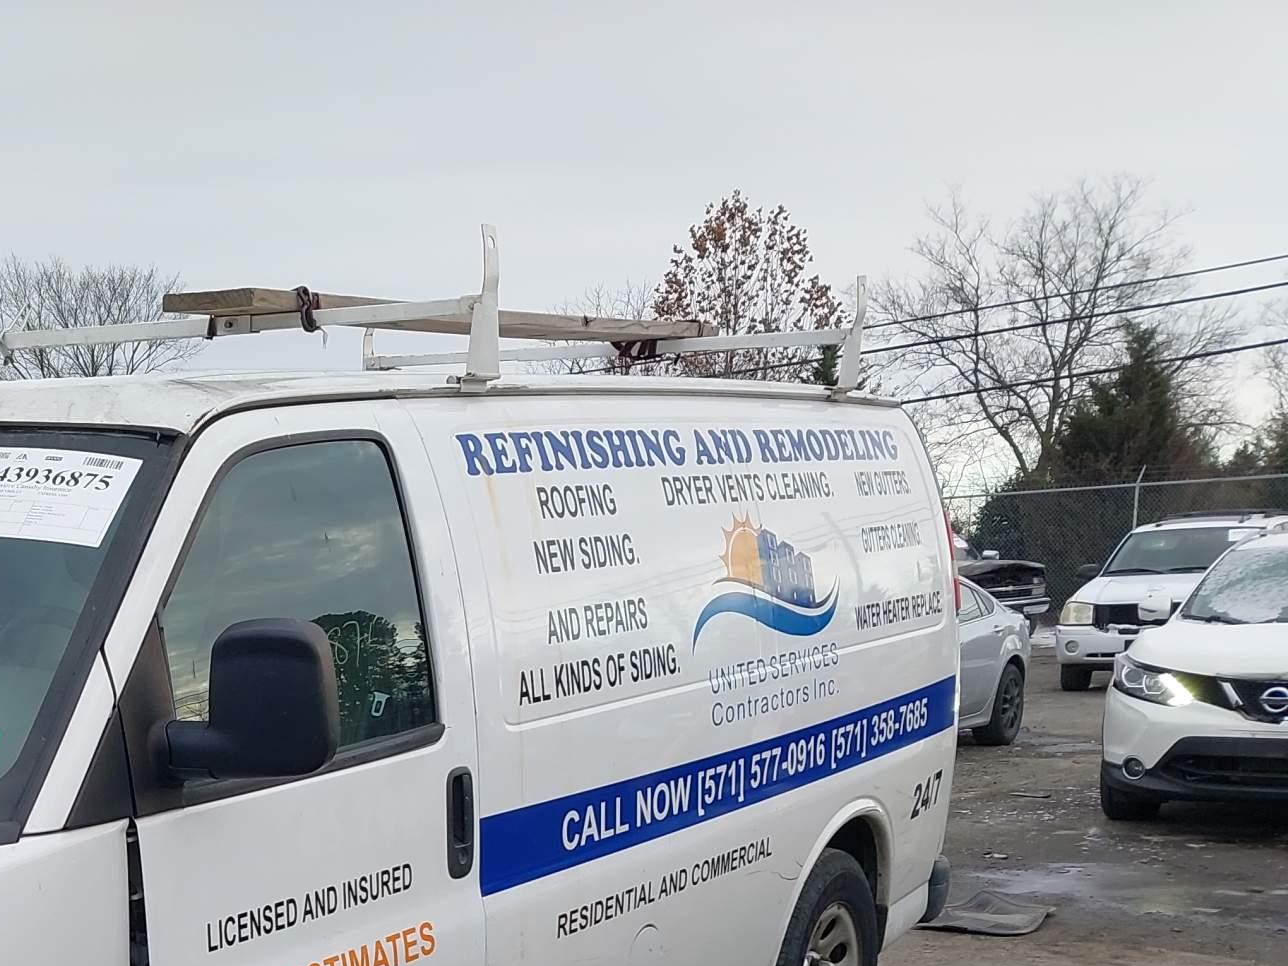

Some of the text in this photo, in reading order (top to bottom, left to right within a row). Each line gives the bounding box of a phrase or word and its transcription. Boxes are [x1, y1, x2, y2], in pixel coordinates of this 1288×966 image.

[455, 428, 899, 477] REFINISHING AND REMODELING
[536, 483, 617, 519] ROOFING
[661, 472, 835, 506] DRYER VENTS CLEANING.
[854, 471, 876, 497] NEW
[533, 533, 641, 575] NEW SIDING.
[861, 524, 892, 553] GUTTERS
[547, 597, 649, 645] AND REPAIRS
[854, 601, 882, 632] WATER
[881, 595, 910, 626] HEATER
[519, 643, 681, 706] ALL KINDS OF SIDING.
[709, 642, 840, 695] UNITED SERVICES
[711, 677, 840, 727] Contractors Inc.
[561, 697, 929, 852] CALL NOW [571] 577-0916 [571] 358-7685
[910, 768, 944, 820] 24/7
[206, 862, 413, 953] LICENSED AND INSURED
[556, 837, 773, 940] RESIDENTIAL AND COMMERCIAL
